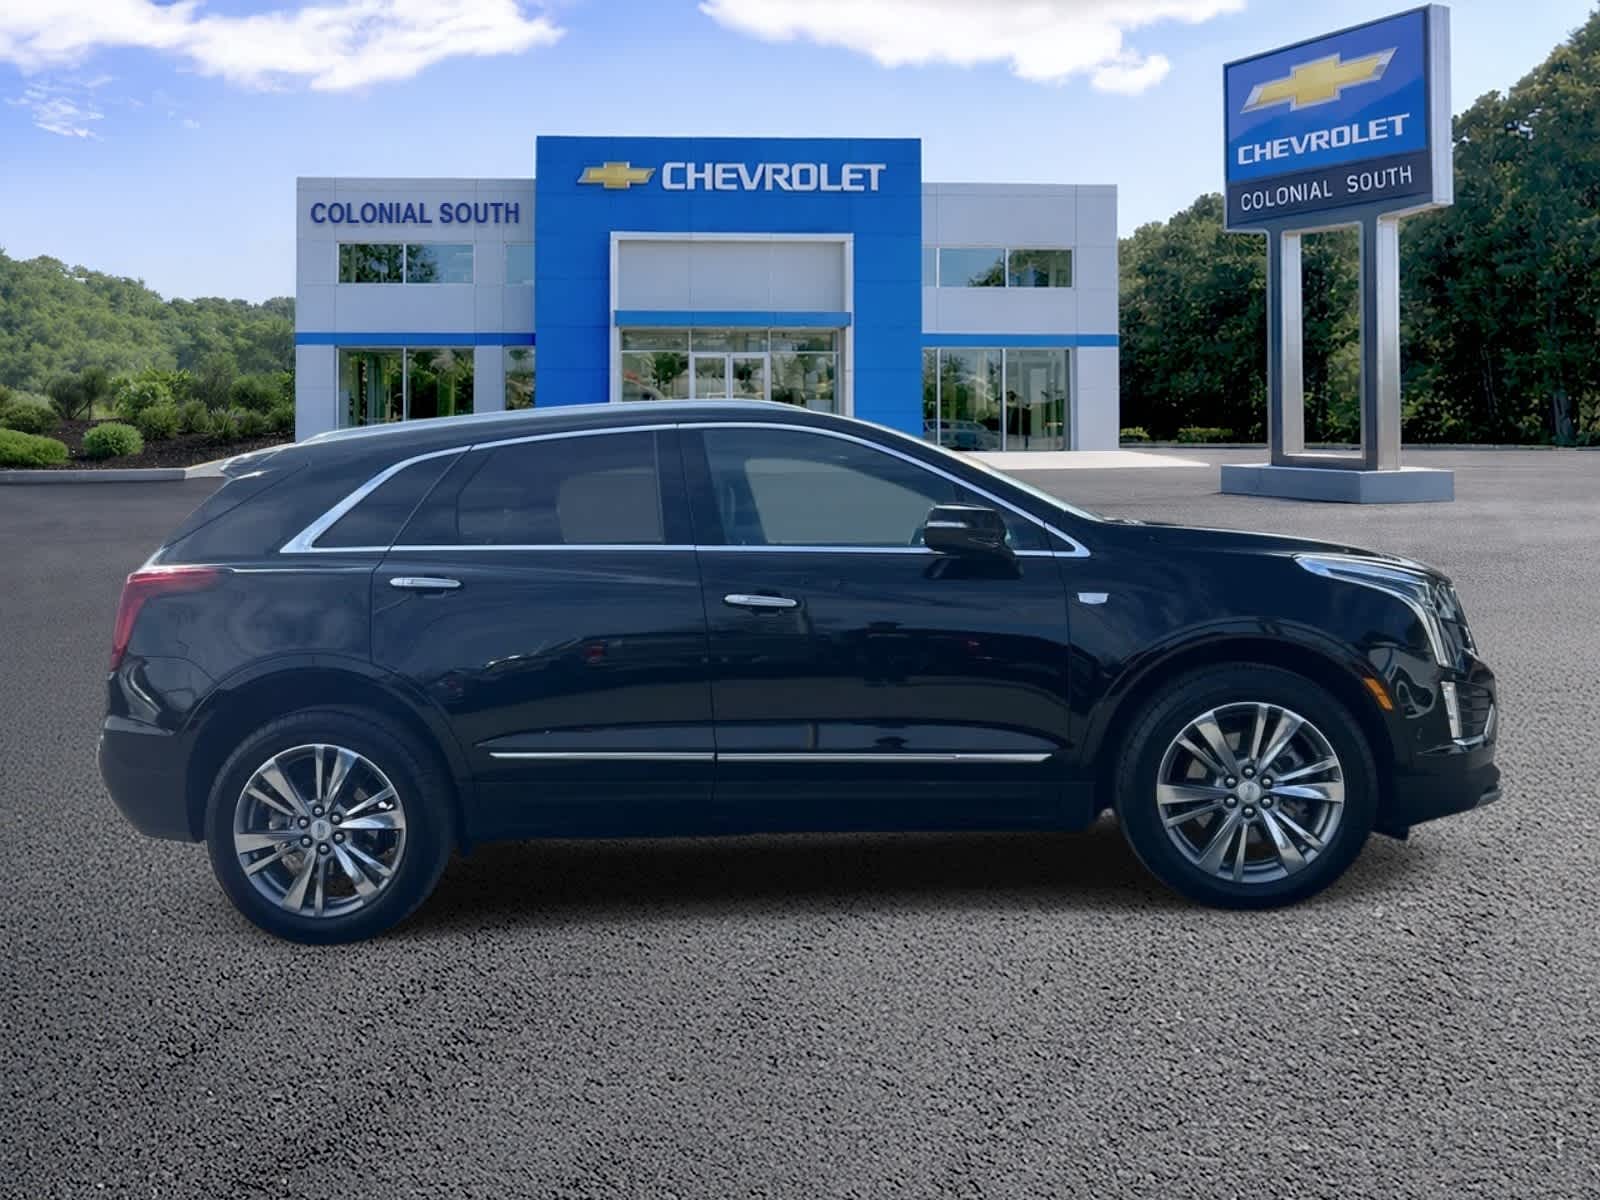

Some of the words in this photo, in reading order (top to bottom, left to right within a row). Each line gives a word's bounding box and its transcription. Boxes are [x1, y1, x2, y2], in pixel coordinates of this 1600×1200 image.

[1238, 113, 1410, 165] CHEVROLET
[662, 162, 887, 192] CHEVROLET
[1241, 180, 1333, 211] COLONIAL
[1346, 165, 1412, 193] SOUTH
[310, 202, 432, 224] COLONIAL
[439, 202, 520, 224] SOUTH
